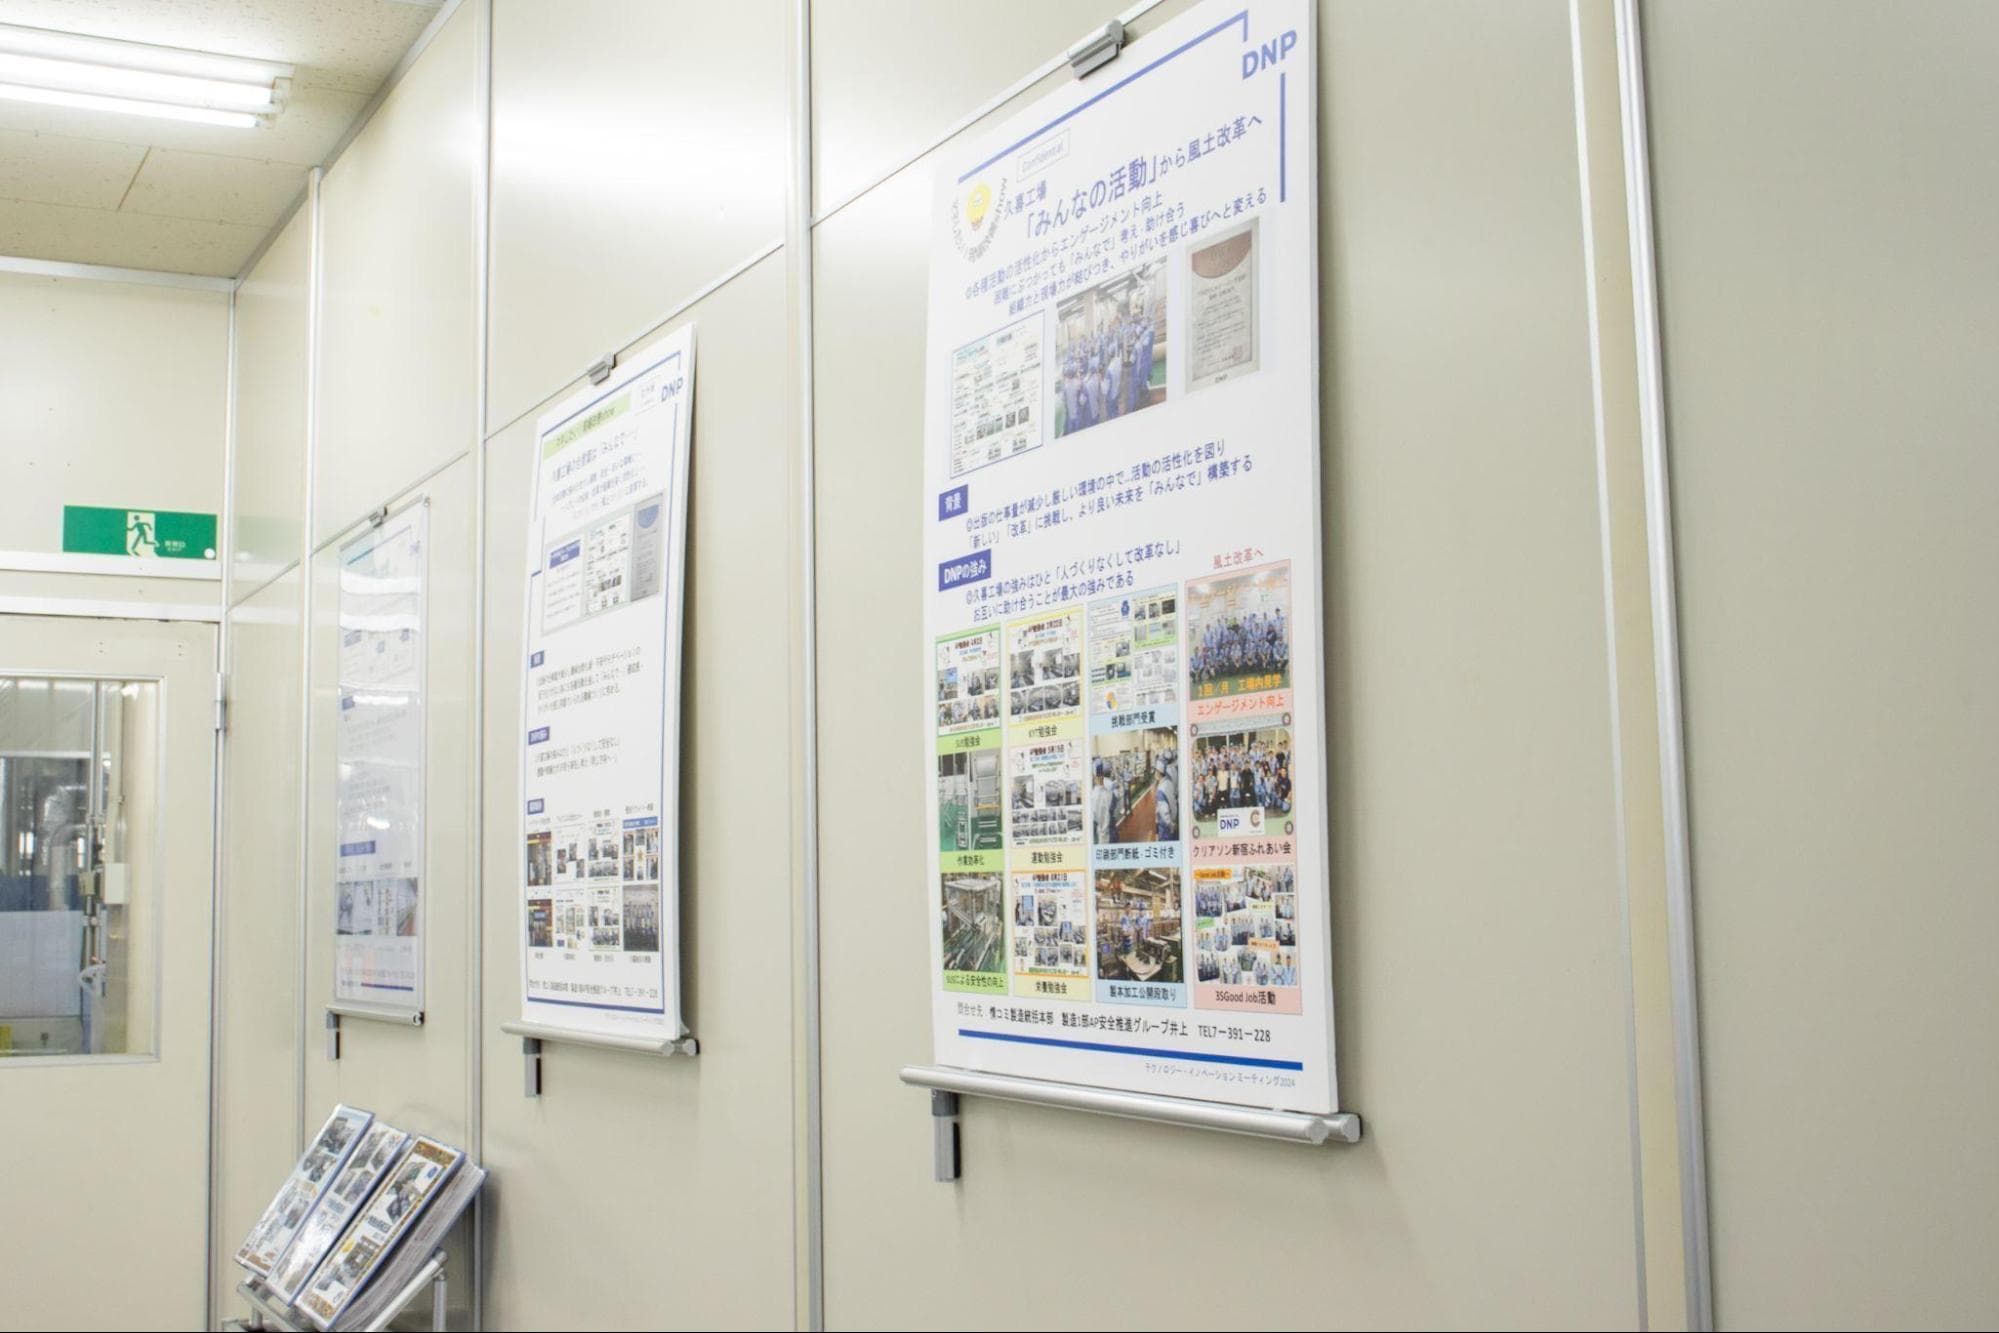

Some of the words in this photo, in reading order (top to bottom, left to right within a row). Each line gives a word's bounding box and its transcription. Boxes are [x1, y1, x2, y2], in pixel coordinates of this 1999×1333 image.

[1242, 30, 1298, 79] DNP
[1027, 115, 1263, 238] 「みんなの活動」から風土改革へ
[662, 377, 684, 402] DNP
[1212, 546, 1265, 570] 風土改革へ
[943, 559, 988, 584] DNPの強み
[1197, 695, 1285, 717] エンゲージメント向上
[1220, 818, 1241, 831] DNP
[1192, 841, 1293, 859] クリアソン新宿ふれあい会
